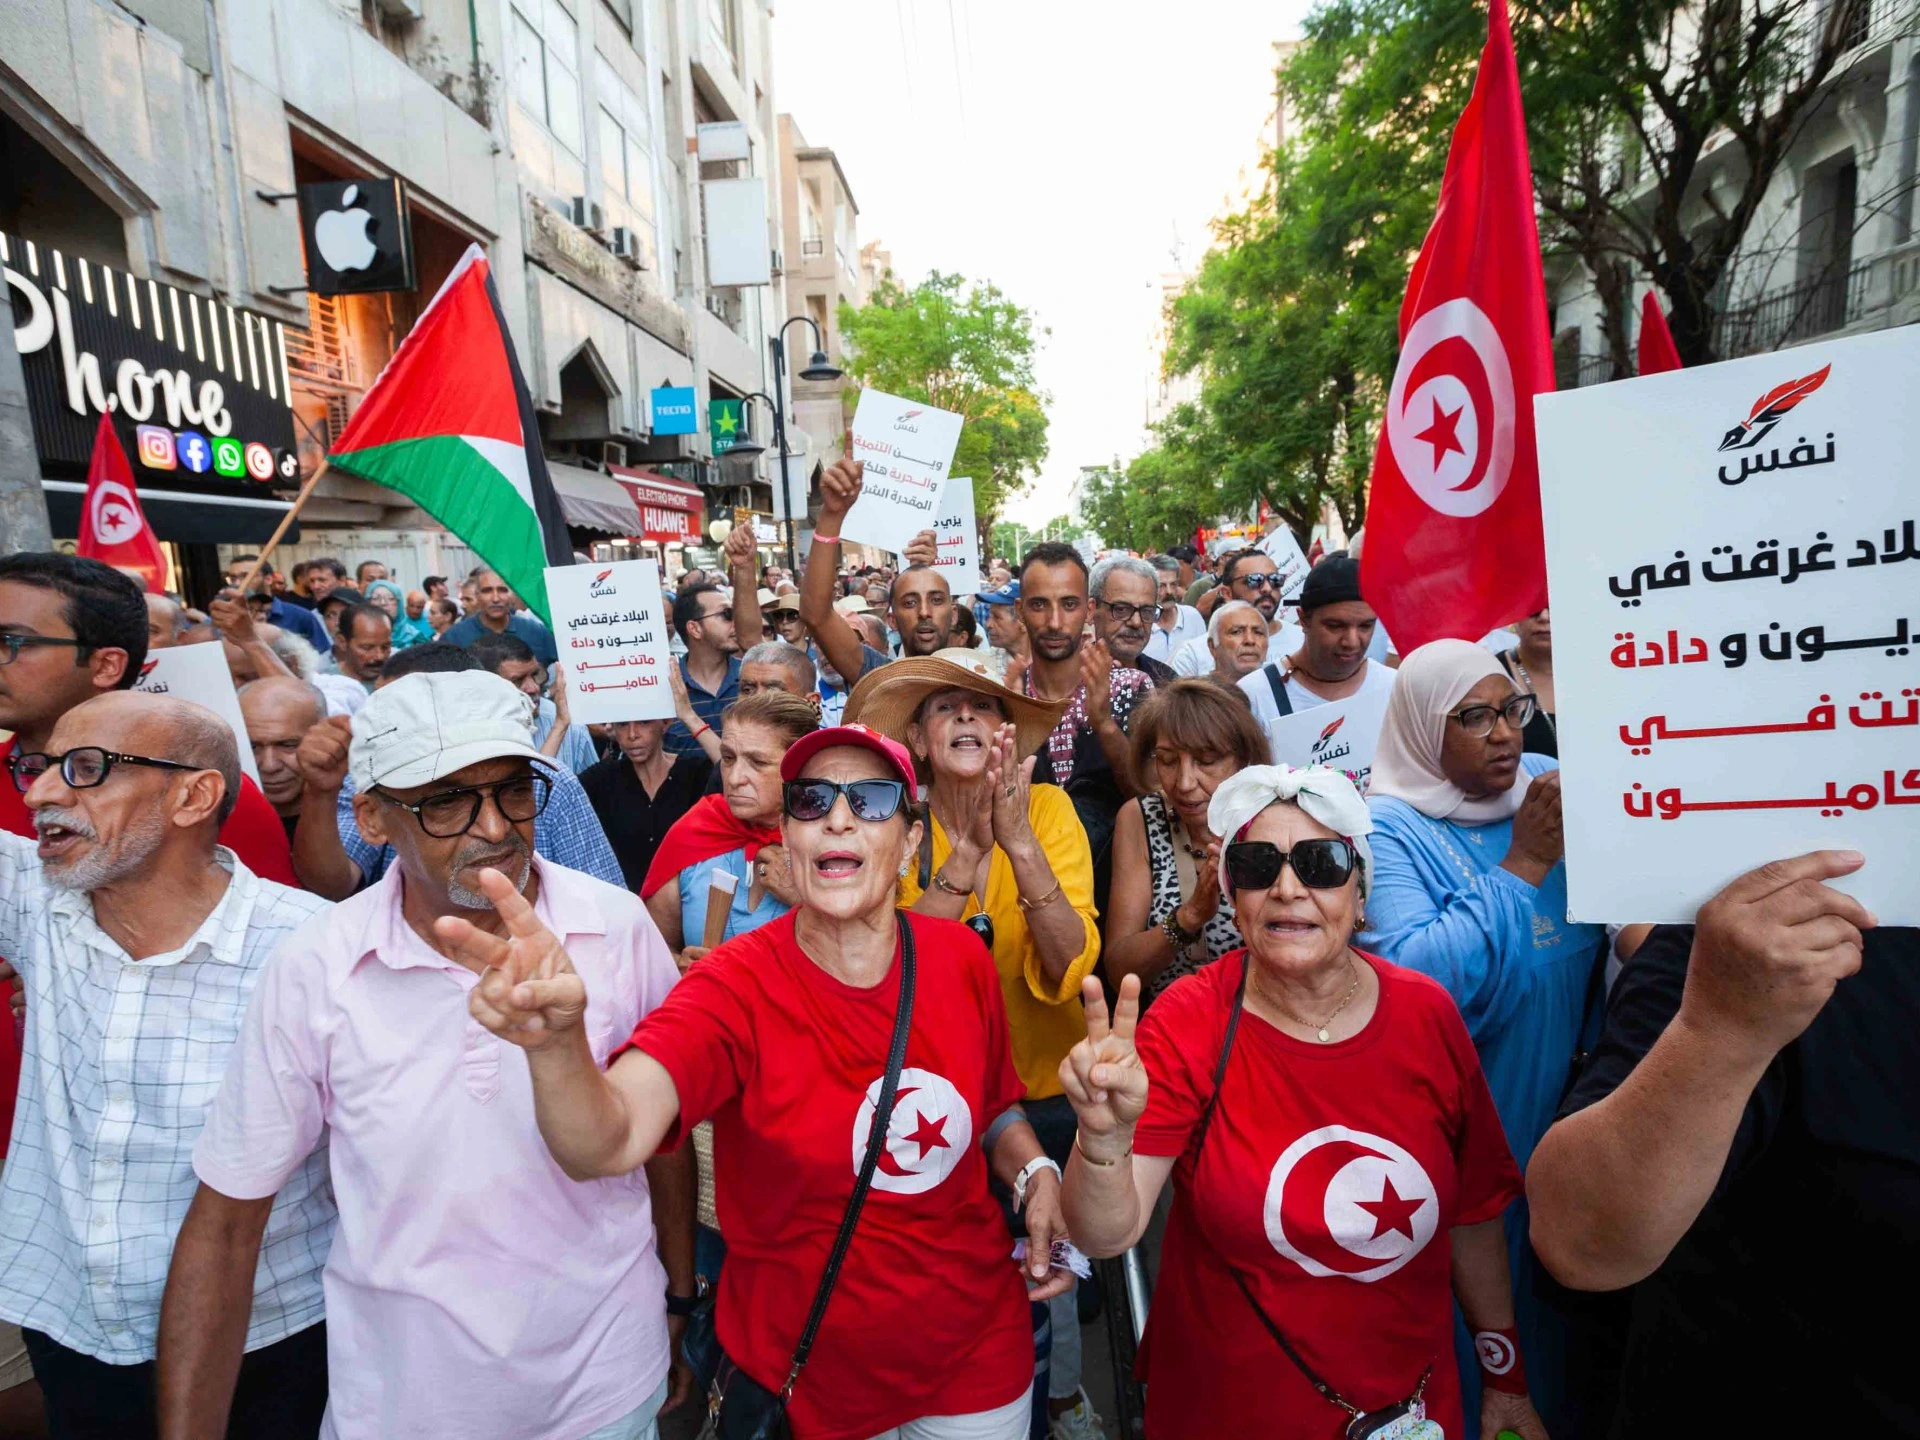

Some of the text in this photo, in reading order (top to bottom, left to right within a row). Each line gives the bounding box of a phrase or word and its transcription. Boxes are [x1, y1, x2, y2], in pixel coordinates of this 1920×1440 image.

[2, 266, 232, 437] Phone
[656, 405, 692, 416] TECNO
[893, 422, 919, 434] نفس
[716, 440, 734, 450] STA
[854, 434, 943, 471] وين التنمية
[1717, 432, 1836, 486] نفس
[637, 487, 688, 507] ELECTRO PHONE
[862, 483, 890, 498] الشر
[644, 507, 689, 534] HUAWEI
[1701, 531, 1837, 585] غرقت
[1608, 550, 1691, 609] في
[590, 586, 617, 598] نفس
[568, 610, 649, 631] البلاد غرقت في
[571, 632, 653, 649] الديون و دادة
[1610, 617, 1920, 669] يون و دادة
[576, 654, 656, 674] ماتت في
[580, 675, 658, 692] الكاميون
[1619, 694, 1836, 757] في
[1623, 769, 1920, 821] كاميون
